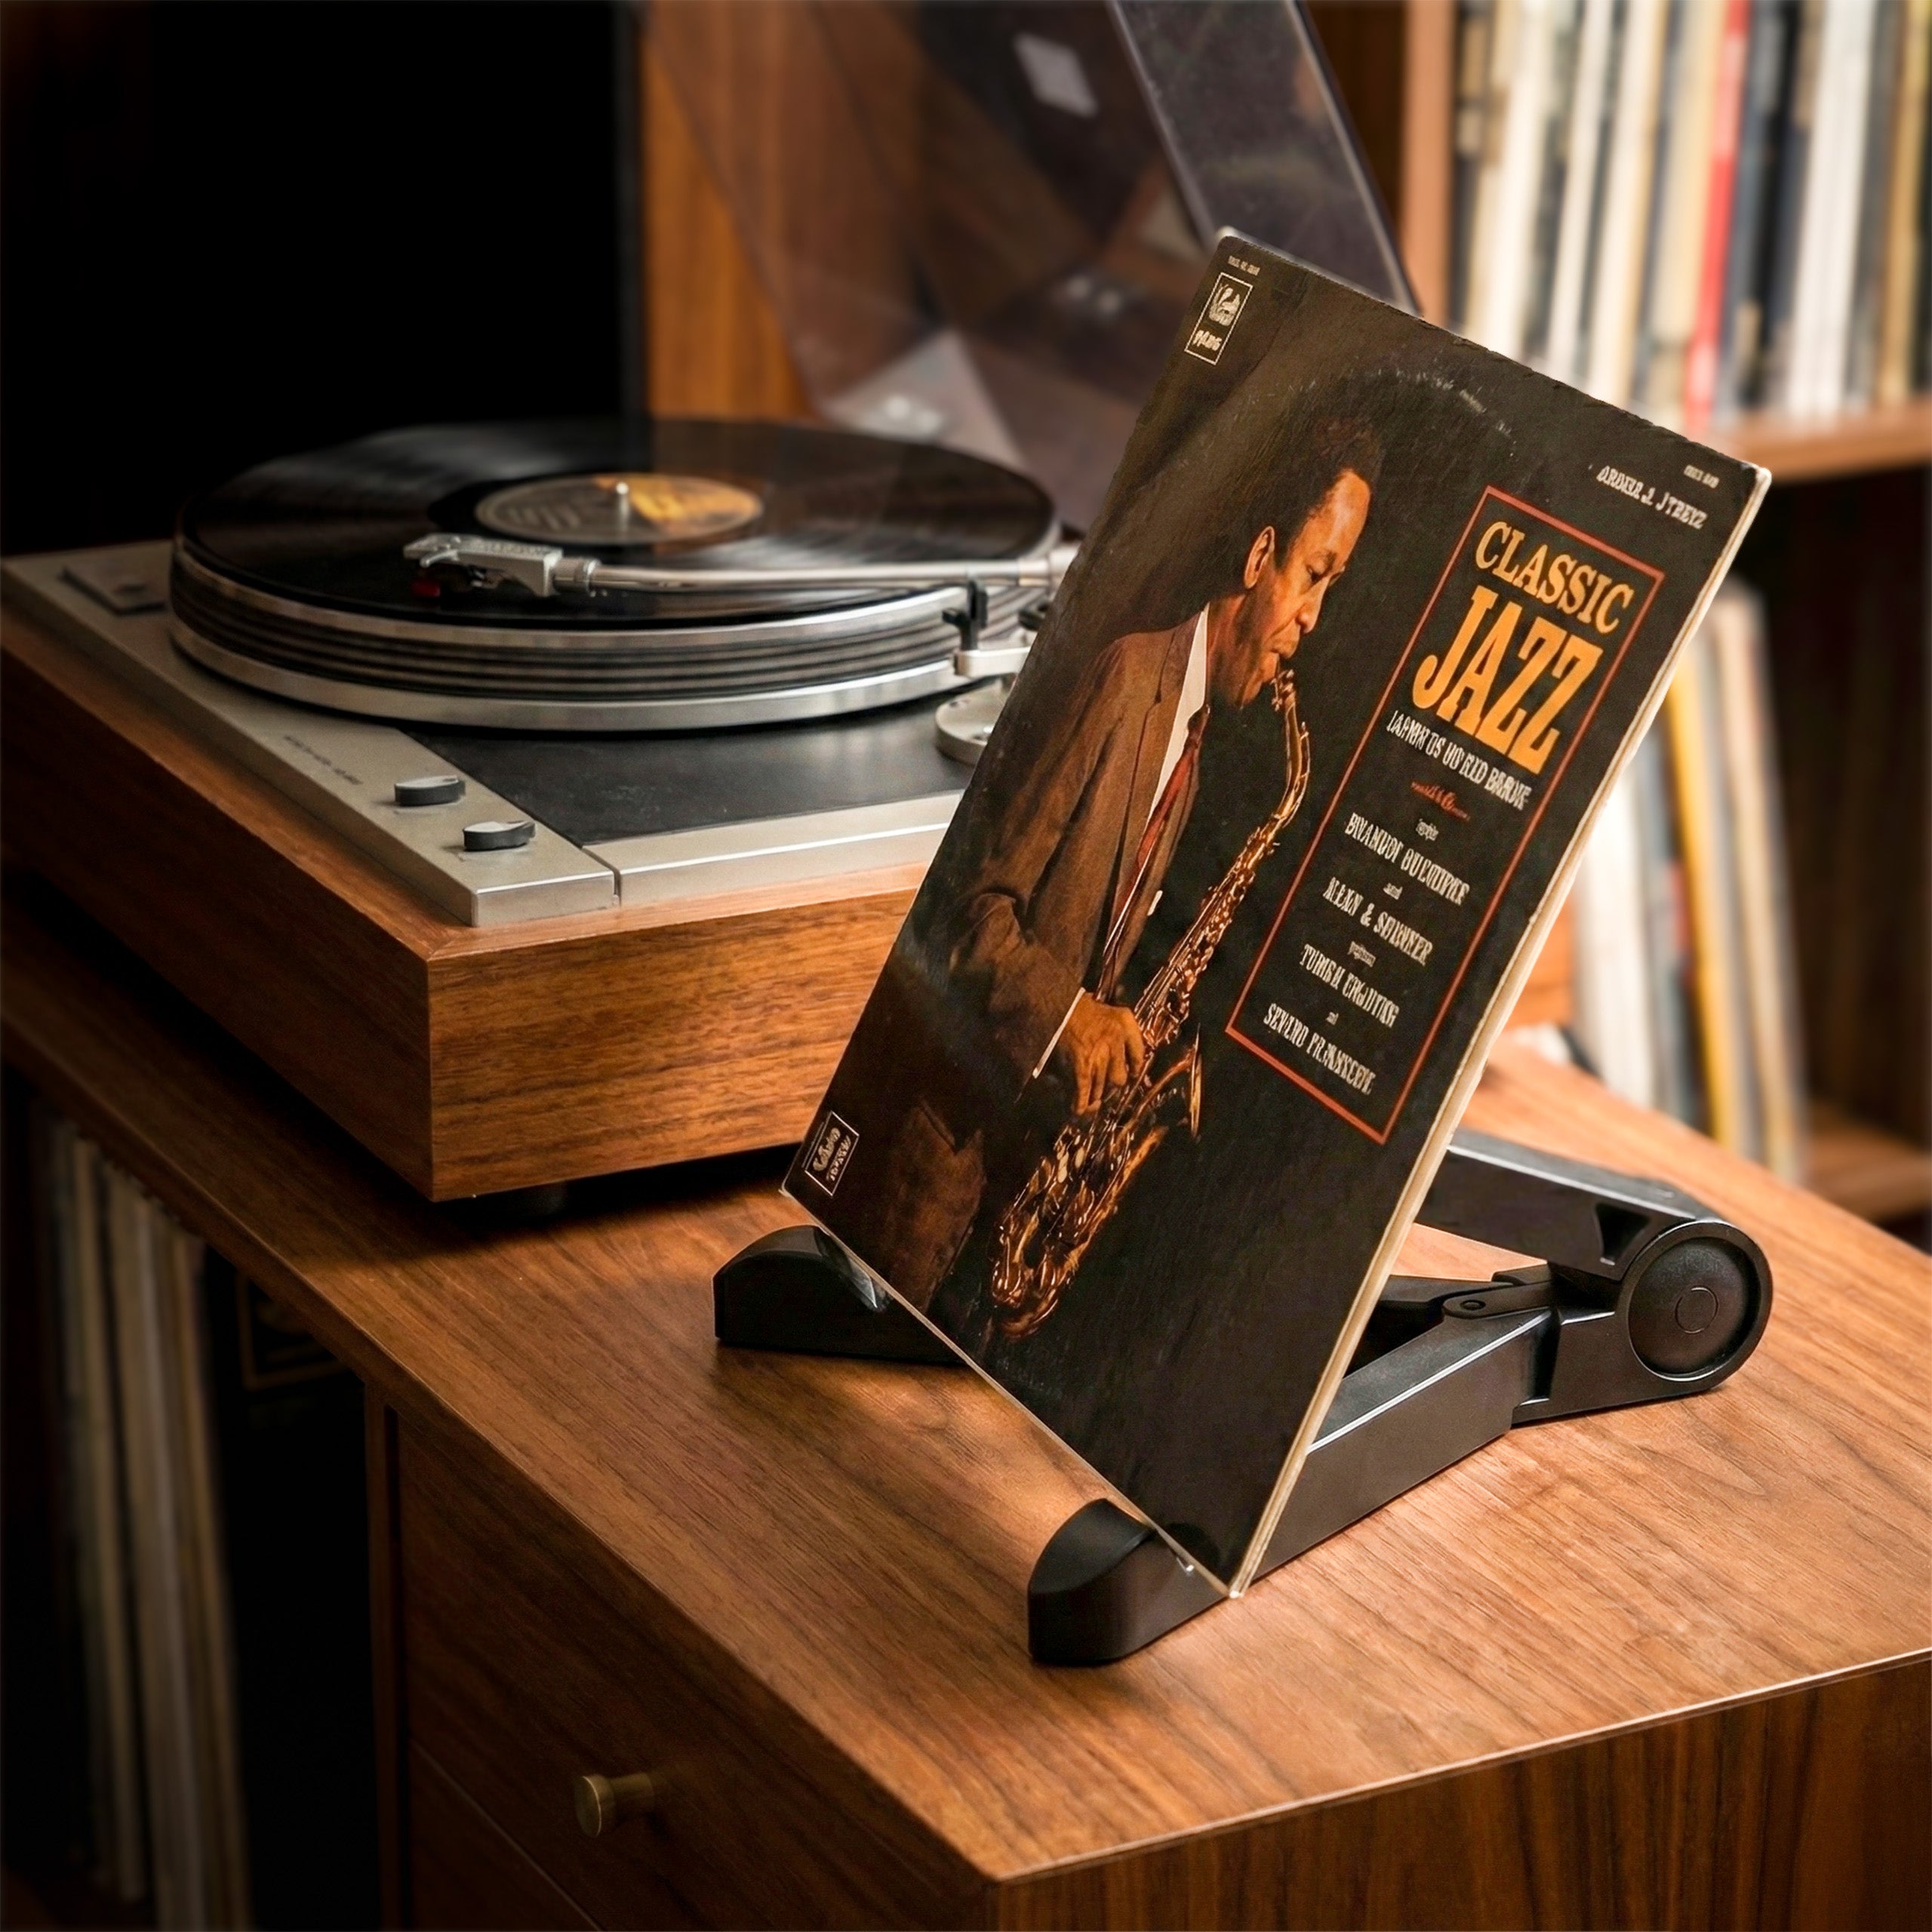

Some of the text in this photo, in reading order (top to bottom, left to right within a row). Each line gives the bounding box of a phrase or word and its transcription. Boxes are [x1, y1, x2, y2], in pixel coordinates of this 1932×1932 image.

[1475, 521, 1634, 634] CLASSIC
[1412, 586, 1603, 774] JAZZ
[1360, 903, 1375, 928] &
